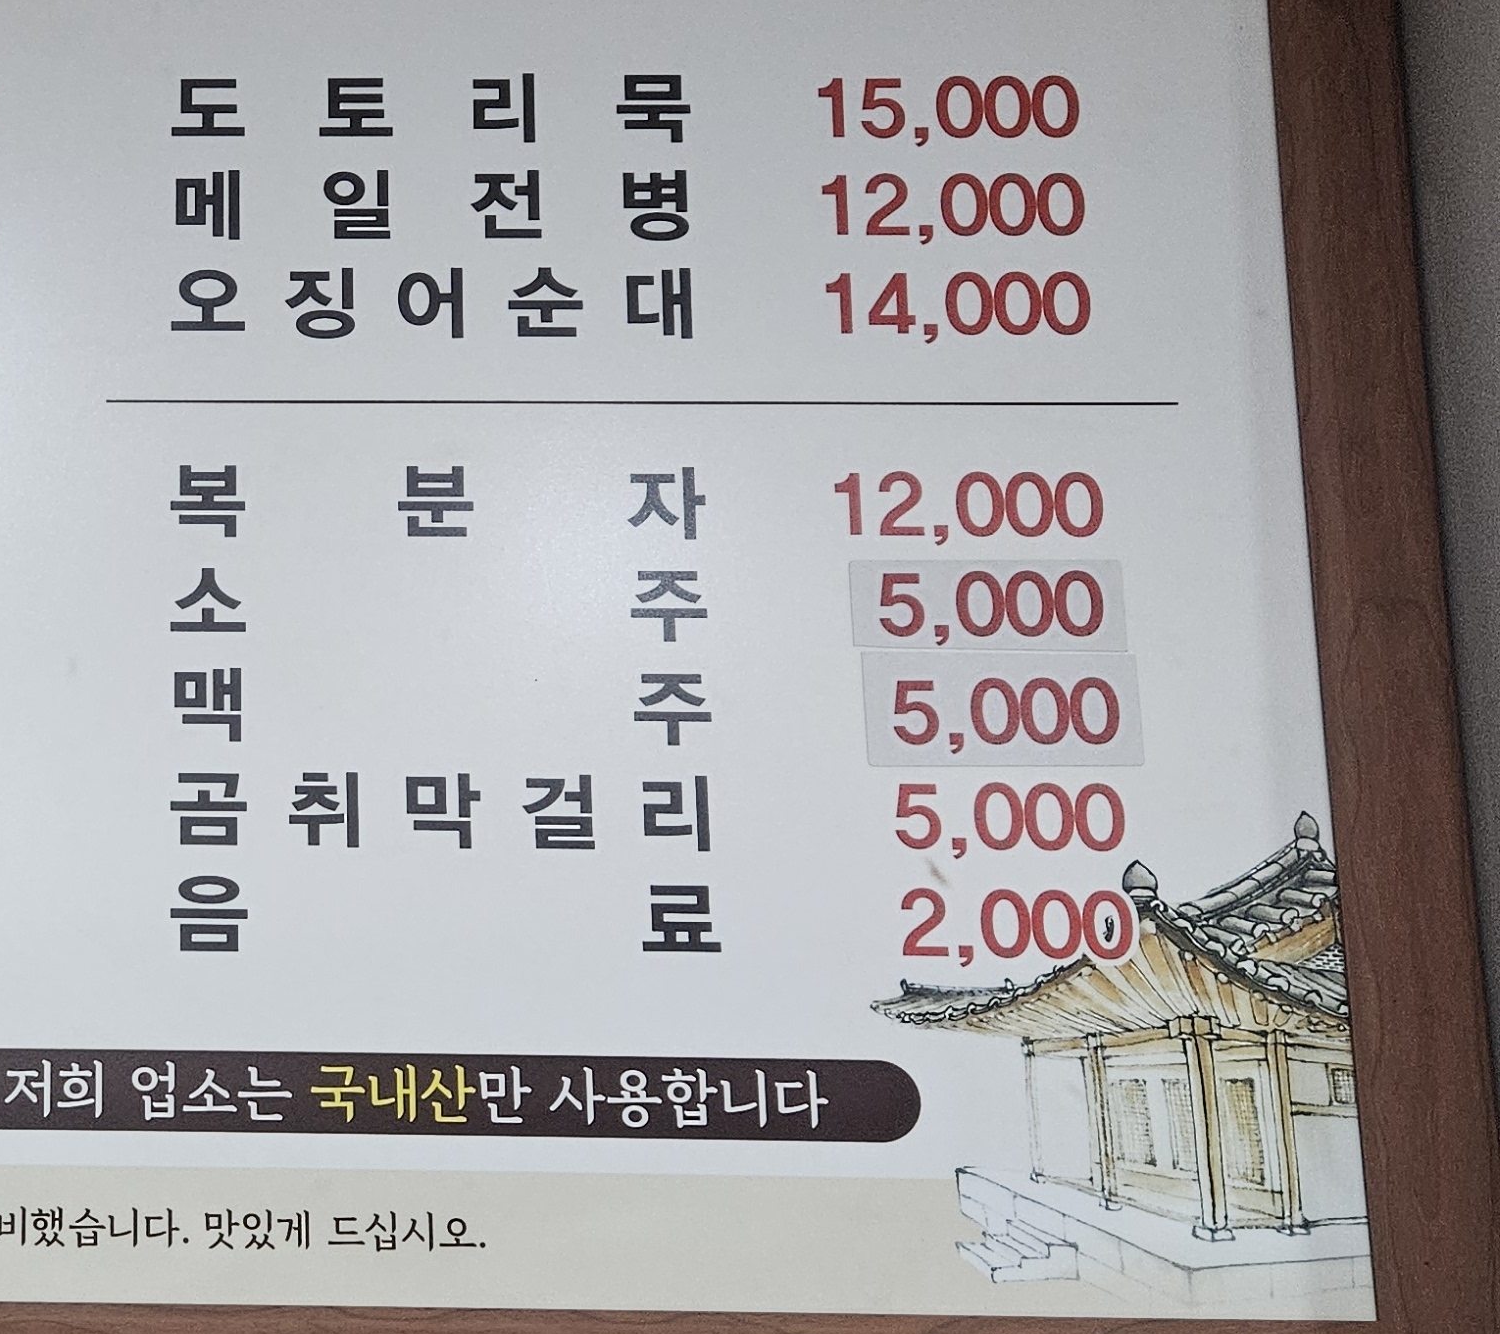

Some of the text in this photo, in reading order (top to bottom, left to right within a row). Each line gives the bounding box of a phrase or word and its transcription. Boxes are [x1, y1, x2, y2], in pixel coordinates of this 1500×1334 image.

[818, 75, 1079, 146] 15,000
[822, 173, 1085, 243] 12,000
[171, 267, 1090, 342] 오징어순대 14,000
[835, 472, 1103, 545] 12,000
[880, 570, 1103, 644] 5,000
[894, 678, 1119, 753] 5,000
[170, 772, 1125, 857] 곰취막걸리 5,000
[902, 888, 1133, 965] 2,000
[5, 1060, 102, 1118] 저희
[132, 1061, 292, 1120] 업소는
[311, 1064, 531, 1123] 국내산만
[550, 1067, 828, 1128] 사용합니다
[205, 1209, 309, 1249] 맛있게
[328, 1211, 485, 1252] 드십시오.
